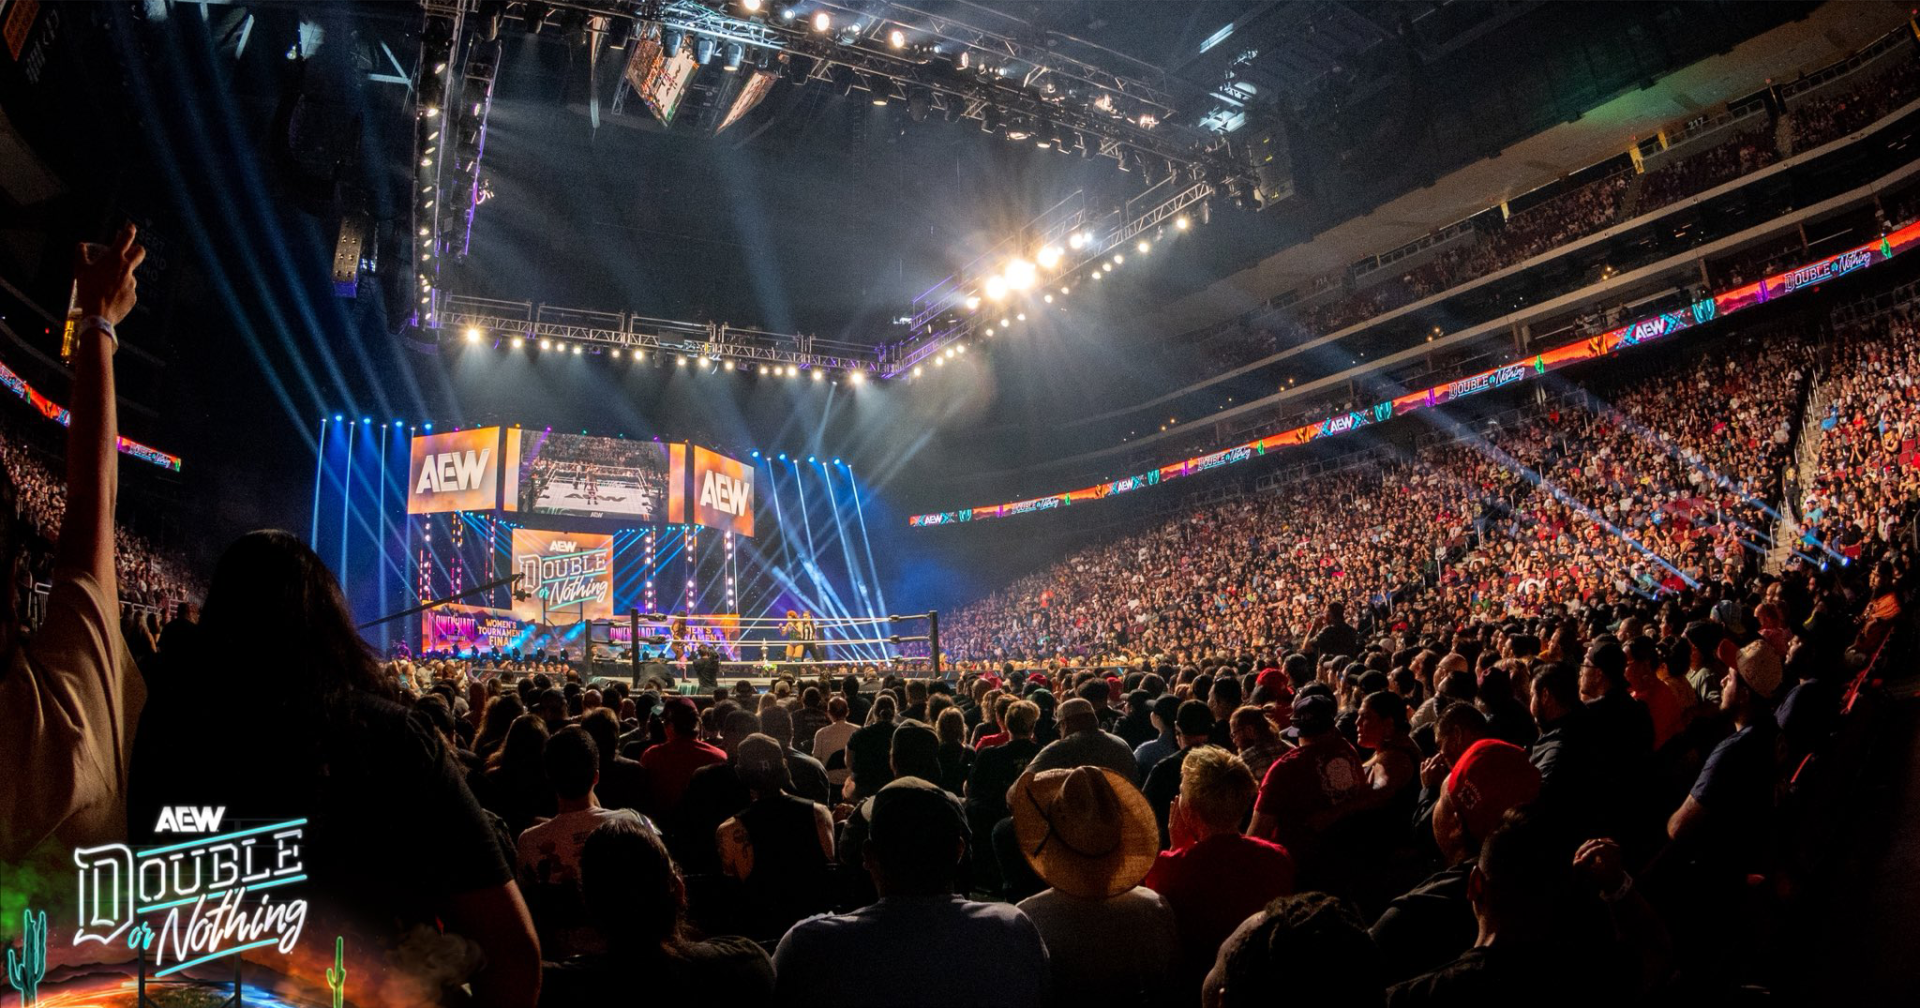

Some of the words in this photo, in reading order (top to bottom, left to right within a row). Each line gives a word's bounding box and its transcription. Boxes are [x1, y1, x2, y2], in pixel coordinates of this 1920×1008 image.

[1784, 262, 1831, 293] DOUBLE
[1838, 250, 1871, 273] Nothing
[1635, 318, 1665, 341] AEW
[1448, 375, 1488, 400] DOUBLE
[1495, 365, 1525, 384] Nothing
[1330, 415, 1353, 432] AEW
[415, 448, 491, 494] AEW
[700, 469, 750, 517] AEW
[1118, 479, 1134, 490] AEW
[924, 513, 943, 524] AEW
[549, 540, 577, 553] AEW
[518, 552, 607, 594] DOUBLE
[538, 586, 550, 600] or
[549, 575, 609, 606] Nothing
[477, 626, 525, 637] TOURNAMENT
[485, 619, 517, 629] WOMEN'S
